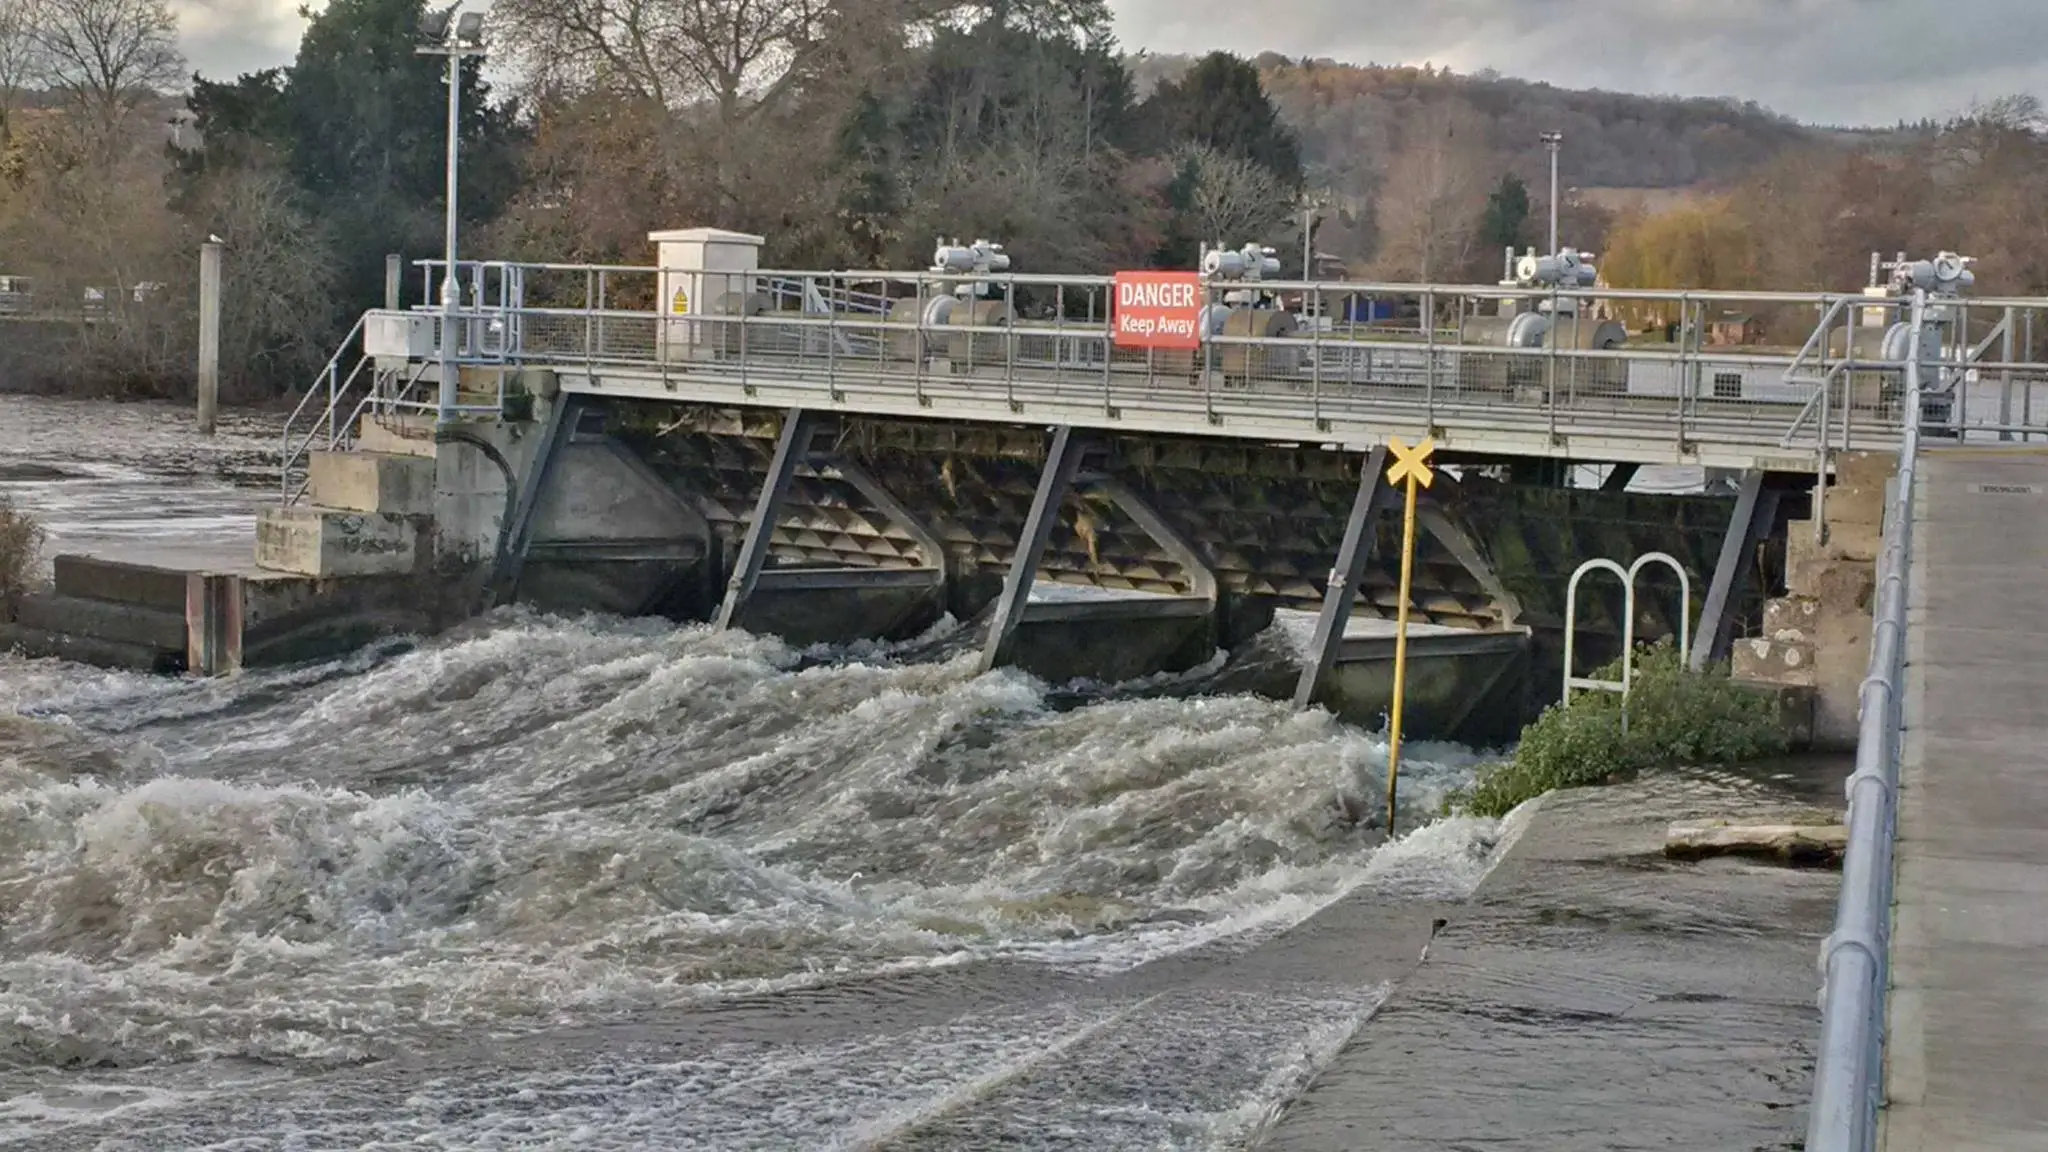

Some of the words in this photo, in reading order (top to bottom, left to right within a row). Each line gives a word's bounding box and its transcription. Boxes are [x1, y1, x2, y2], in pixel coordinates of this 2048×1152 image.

[1121, 283, 1194, 306] DANGER
[1120, 315, 1155, 337] Keep
[1157, 316, 1195, 338] Away
